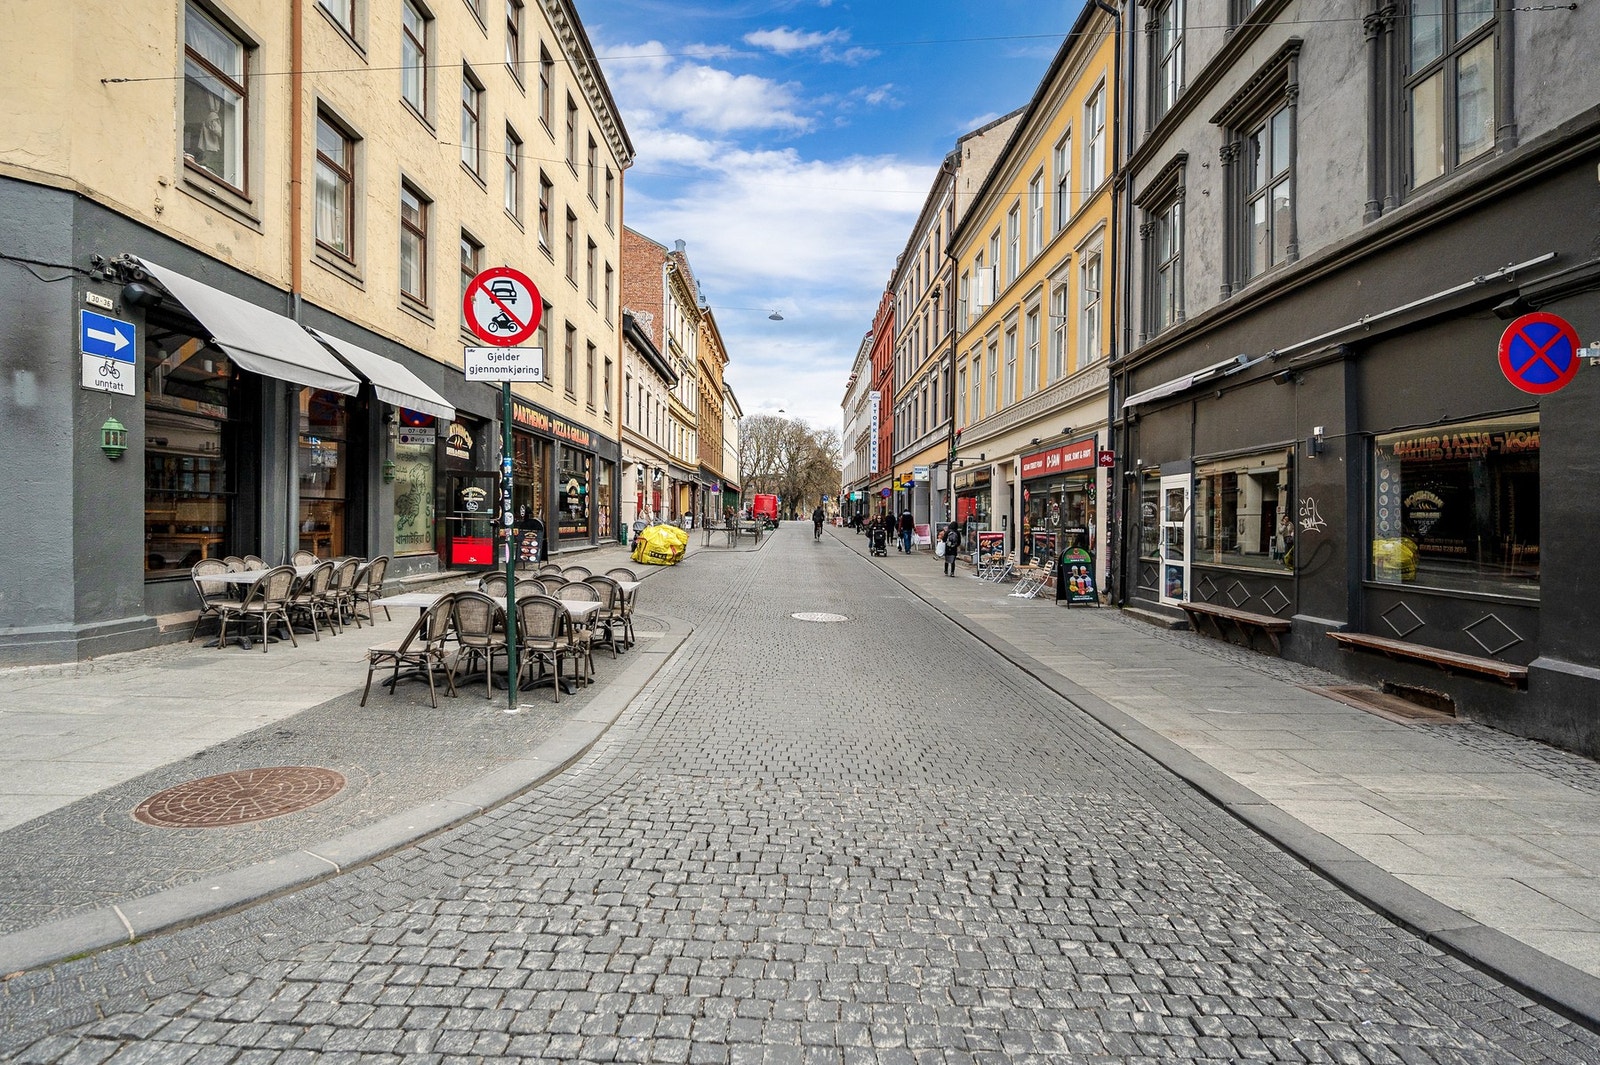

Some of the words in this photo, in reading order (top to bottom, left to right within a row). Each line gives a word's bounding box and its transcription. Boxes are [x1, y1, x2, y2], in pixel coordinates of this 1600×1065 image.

[487, 353, 520, 363] Gjelder
[469, 365, 540, 376] gjennomkjøring
[94, 379, 124, 390] unntatt
[513, 402, 549, 432] PARTHENON
